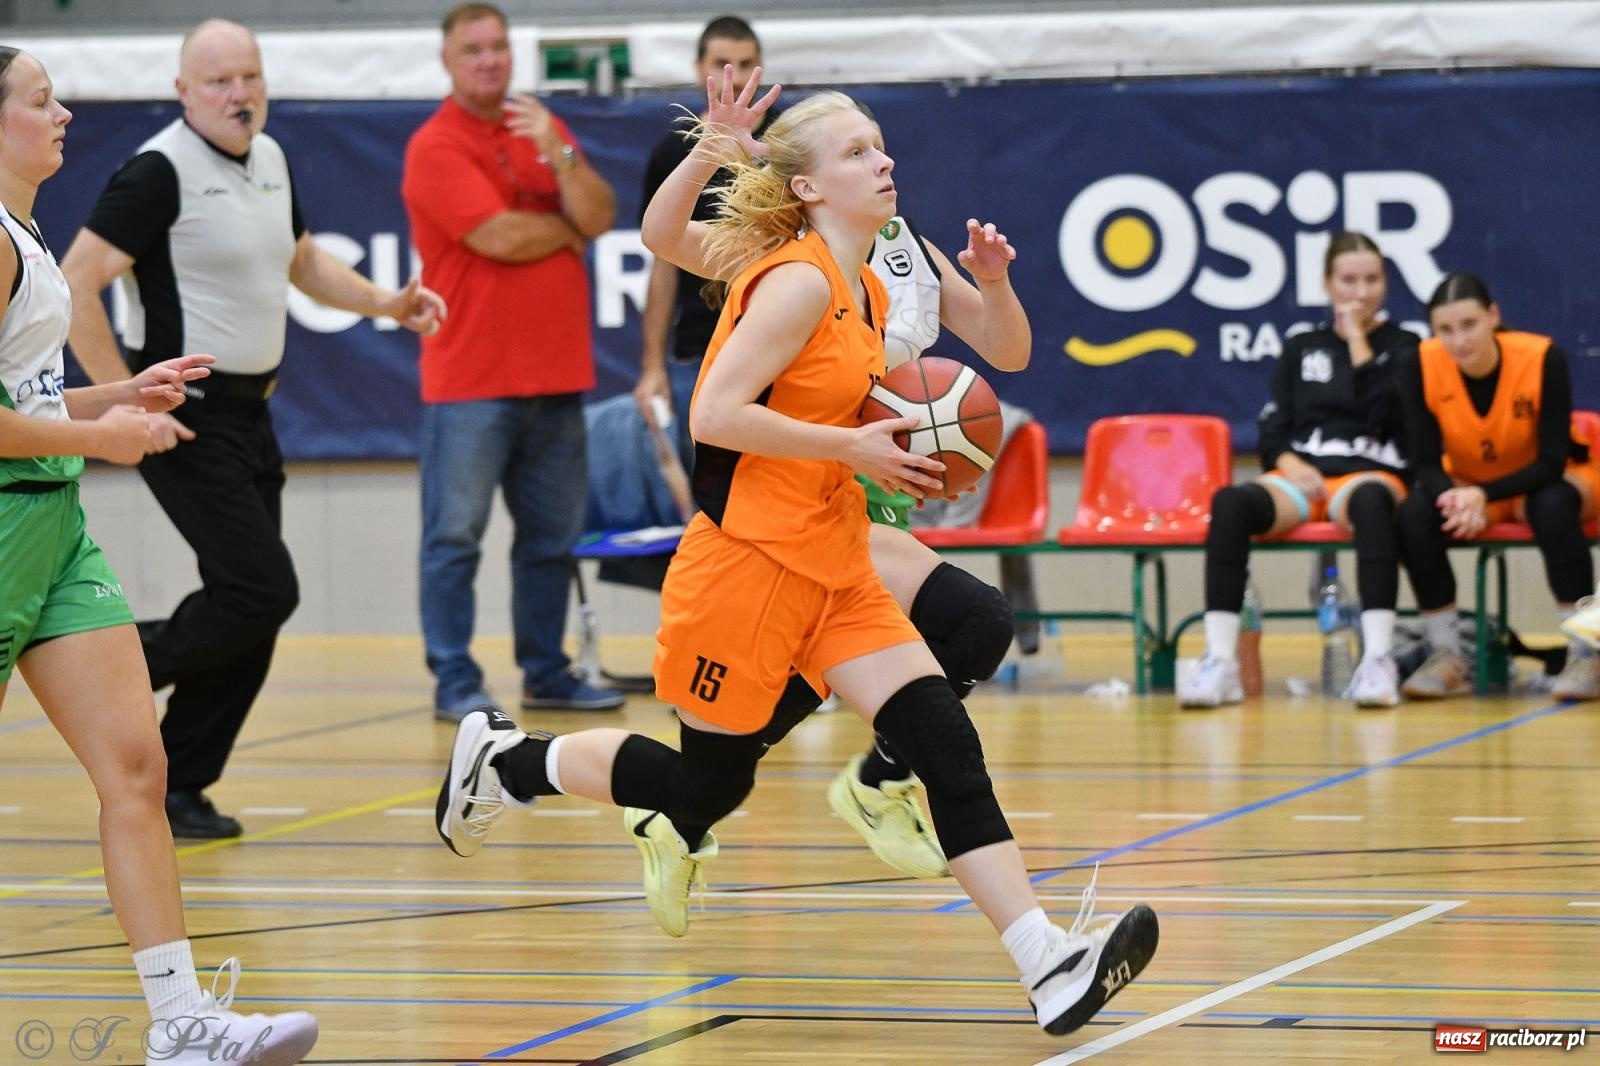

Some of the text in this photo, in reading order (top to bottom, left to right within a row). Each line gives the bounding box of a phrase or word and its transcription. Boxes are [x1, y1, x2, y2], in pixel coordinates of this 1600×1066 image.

[1058, 171, 1453, 312] OSiR
[1480, 439, 1498, 462] 2
[689, 654, 729, 703] 15
